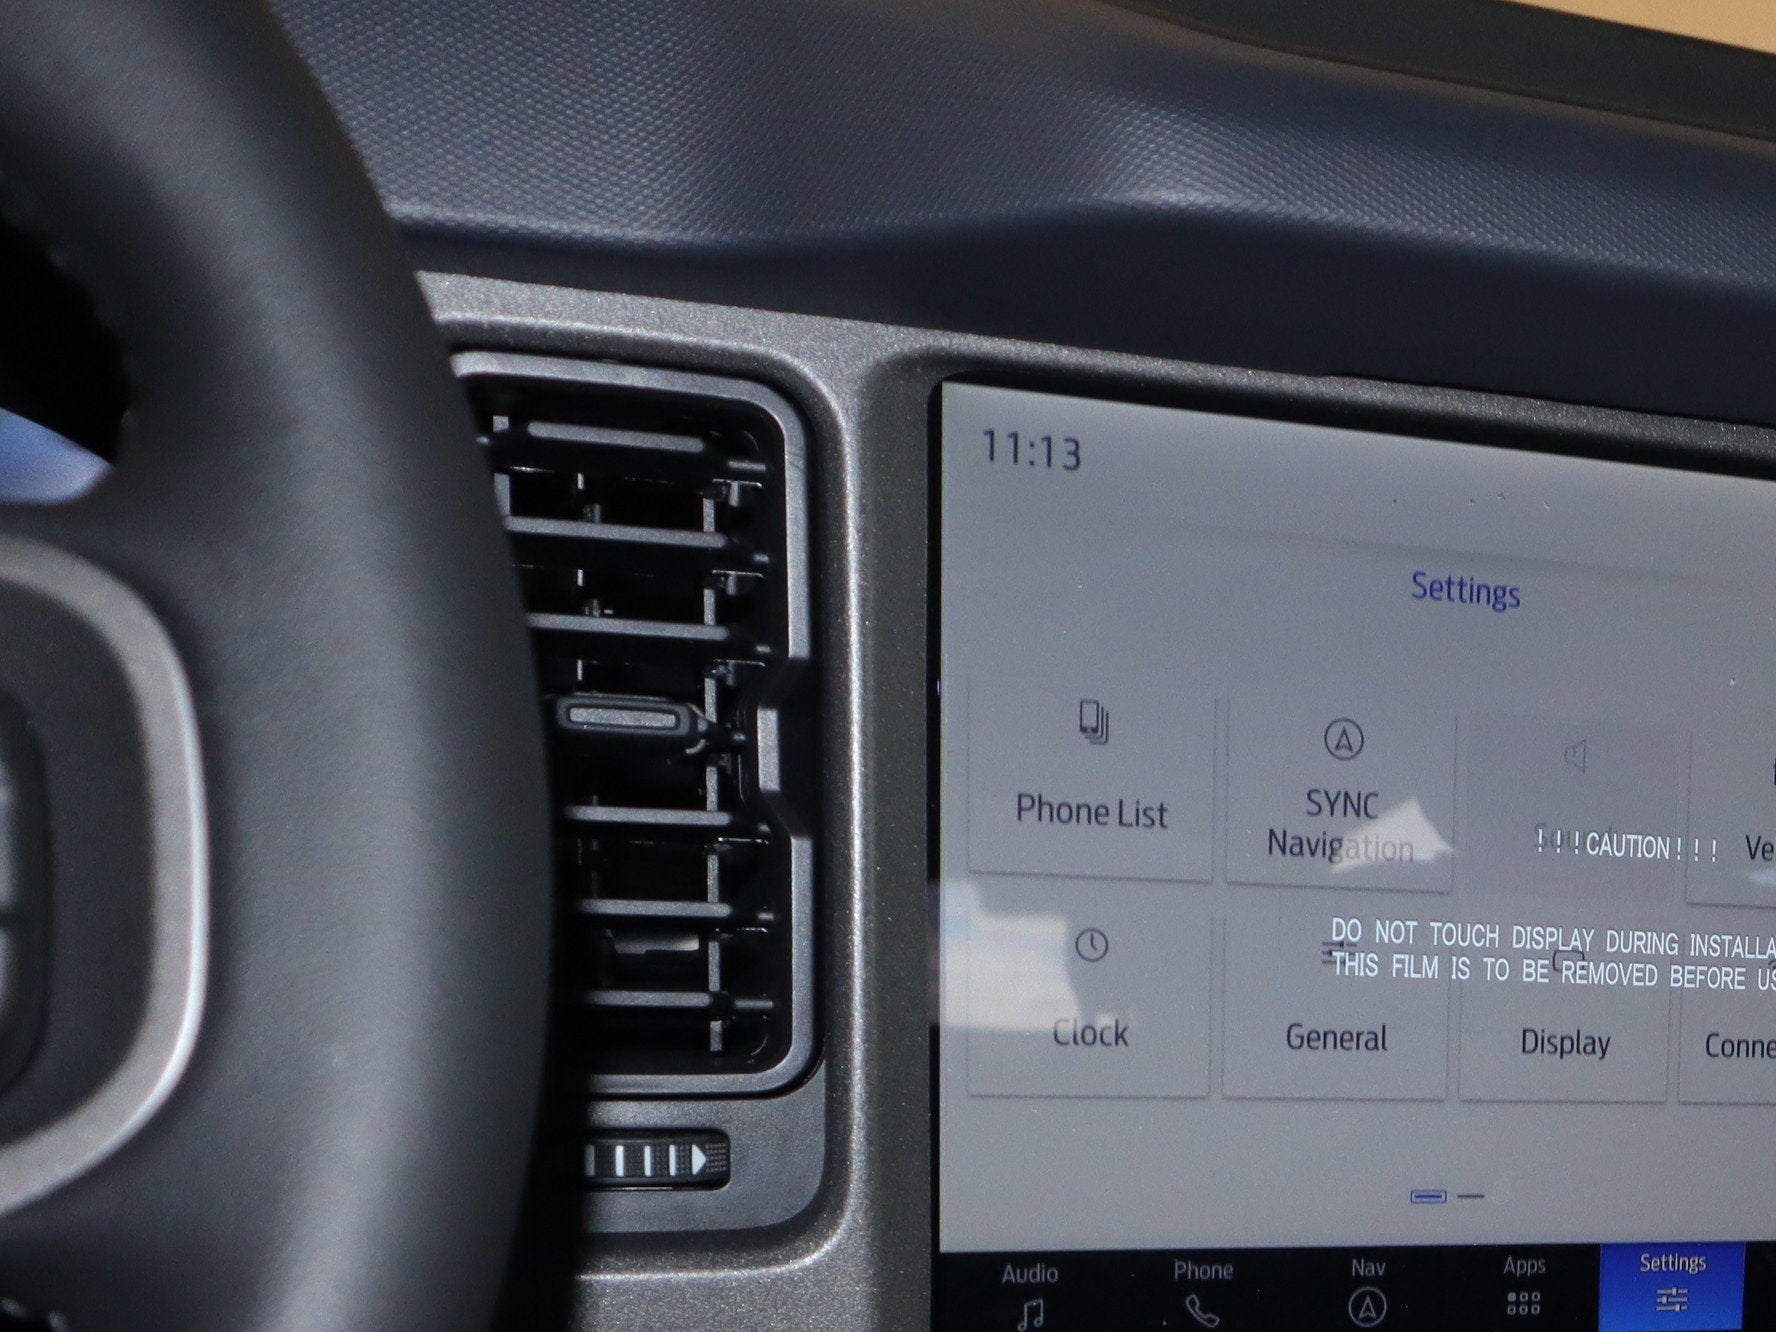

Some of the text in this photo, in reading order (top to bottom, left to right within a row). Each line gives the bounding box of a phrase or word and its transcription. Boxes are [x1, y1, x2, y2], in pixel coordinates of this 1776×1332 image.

[983, 429, 1082, 471] 11:13
[1411, 572, 1521, 611] Settings
[1017, 793, 1169, 829] Phone List
[1306, 790, 1379, 819] SYNC
[1268, 828, 1414, 865] Navigation
[1332, 918, 1362, 943] DO
[1376, 919, 1418, 945] NOT
[1430, 922, 1499, 948] TOUCH
[1513, 925, 1595, 952] DISPLAY
[1606, 930, 1679, 955] DURING
[1332, 951, 1378, 978] THIS
[1392, 954, 1439, 980] FILM
[1451, 956, 1471, 981] IS
[1483, 957, 1510, 982] TO
[1522, 959, 1549, 983] BE
[1562, 960, 1658, 987] REMOVED
[1670, 964, 1746, 990] BEFORE
[1053, 1017, 1129, 1047] Clock
[1286, 1024, 1388, 1051] General
[1521, 1028, 1611, 1060] Display
[1002, 1263, 1059, 1284] Audio
[1174, 1259, 1233, 1281] Phone
[1352, 1258, 1386, 1277] Nav
[1504, 1255, 1545, 1277] Apps
[1640, 1253, 1706, 1274] Settings
